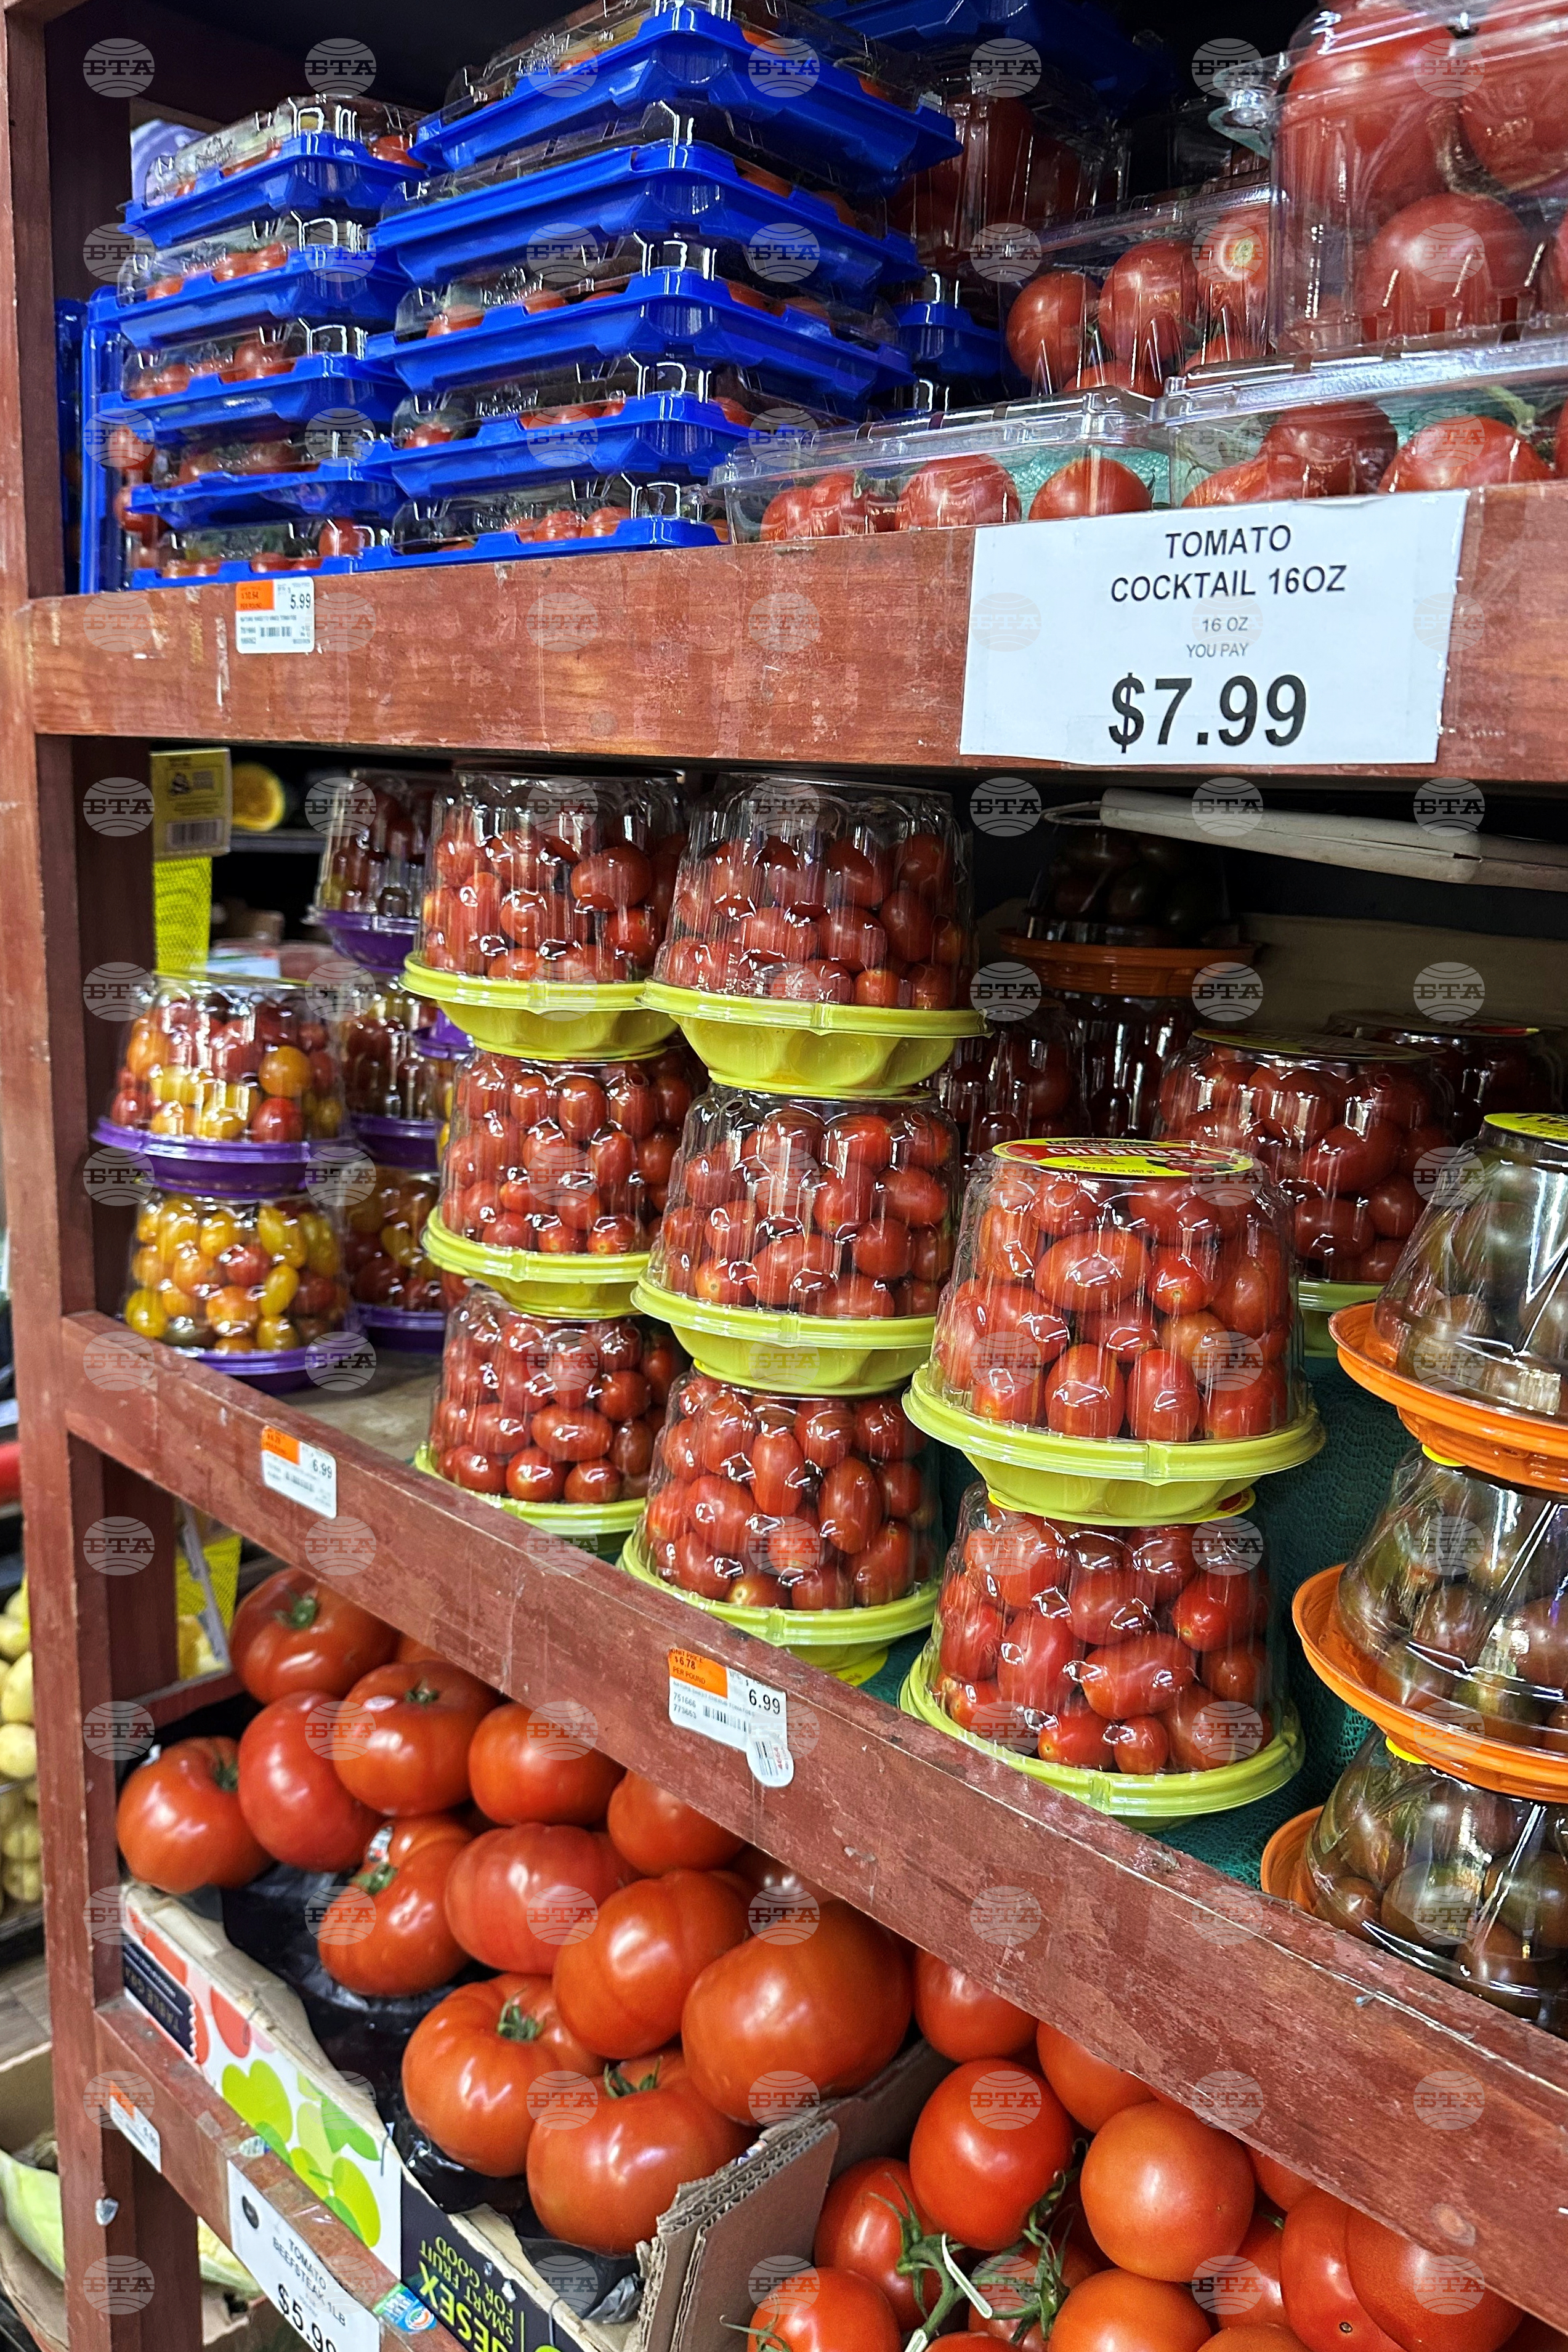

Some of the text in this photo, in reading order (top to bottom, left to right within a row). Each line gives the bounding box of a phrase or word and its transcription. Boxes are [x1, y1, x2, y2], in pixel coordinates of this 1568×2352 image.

[1165, 523, 1291, 559] TOMATO
[1111, 564, 1348, 602] COCKTAIL 16OZ
[290, 593, 311, 610] 5.99
[1202, 618, 1221, 633] 16
[1227, 616, 1249, 632] OZ
[1186, 642, 1250, 659] YOU PAY
[1109, 672, 1307, 753] $7.99
[1046, 1147, 1191, 1157] CHERUBS
[312, 1458, 333, 1479] 6.99
[673, 1666, 706, 1685] PER POUND
[674, 1655, 696, 1670] $6.78
[749, 1688, 780, 1715] 6.99
[288, 2238, 327, 2290] TOMATO
[419, 2239, 459, 2290] FRUIT
[435, 2236, 480, 2289] GOOD
[272, 2236, 326, 2306] BEEFSTEAK
[327, 2301, 346, 2327] 1LB
[464, 2284, 514, 2345] SMART
[484, 2281, 514, 2326] FOR
